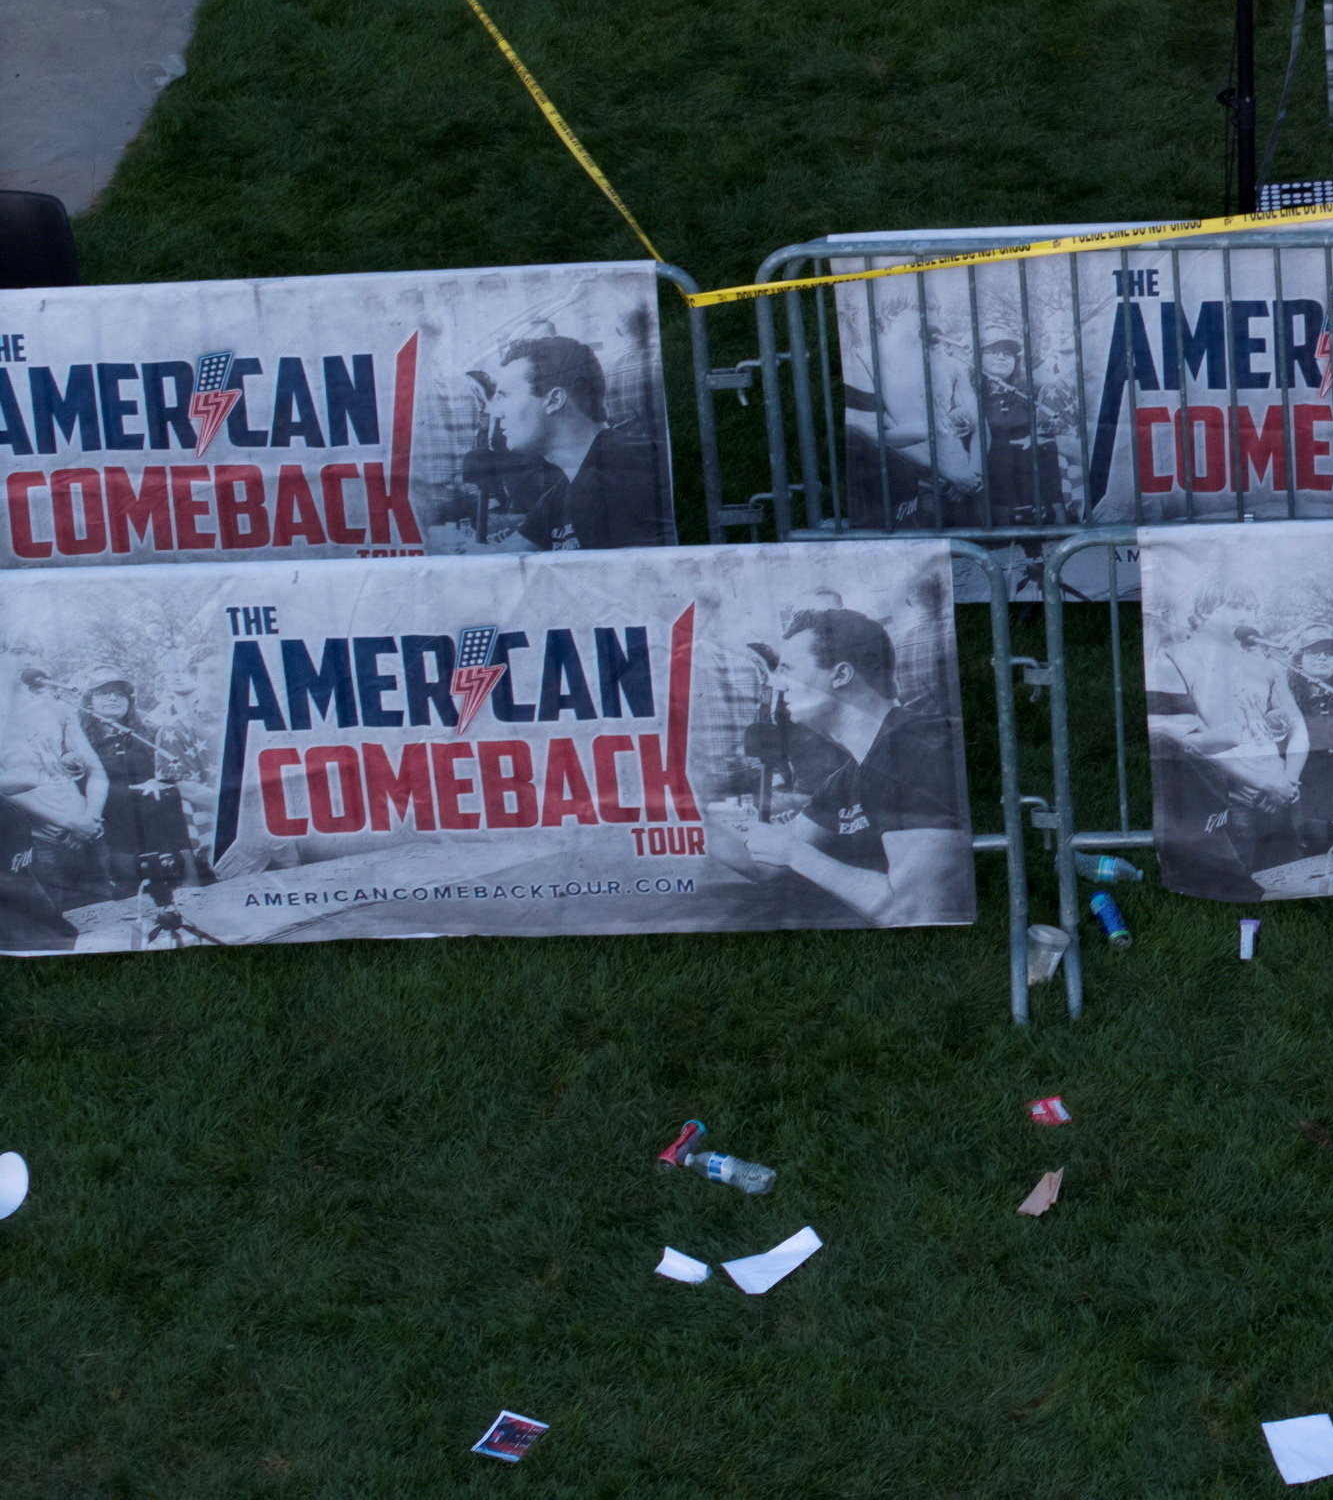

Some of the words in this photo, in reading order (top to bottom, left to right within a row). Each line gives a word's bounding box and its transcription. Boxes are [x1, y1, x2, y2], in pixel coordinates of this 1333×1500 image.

[1112, 268, 1159, 298] THE
[0, 333, 27, 363] HE
[0, 351, 380, 460] AMERICAN
[6, 330, 424, 559] COMEBACK
[226, 607, 279, 636] THE
[258, 601, 698, 838] COMEBACK
[212, 625, 656, 866] AMERICAN
[631, 826, 706, 858] TOUR
[244, 877, 697, 909] AMERICANCOMEBACKTOUR.COM
